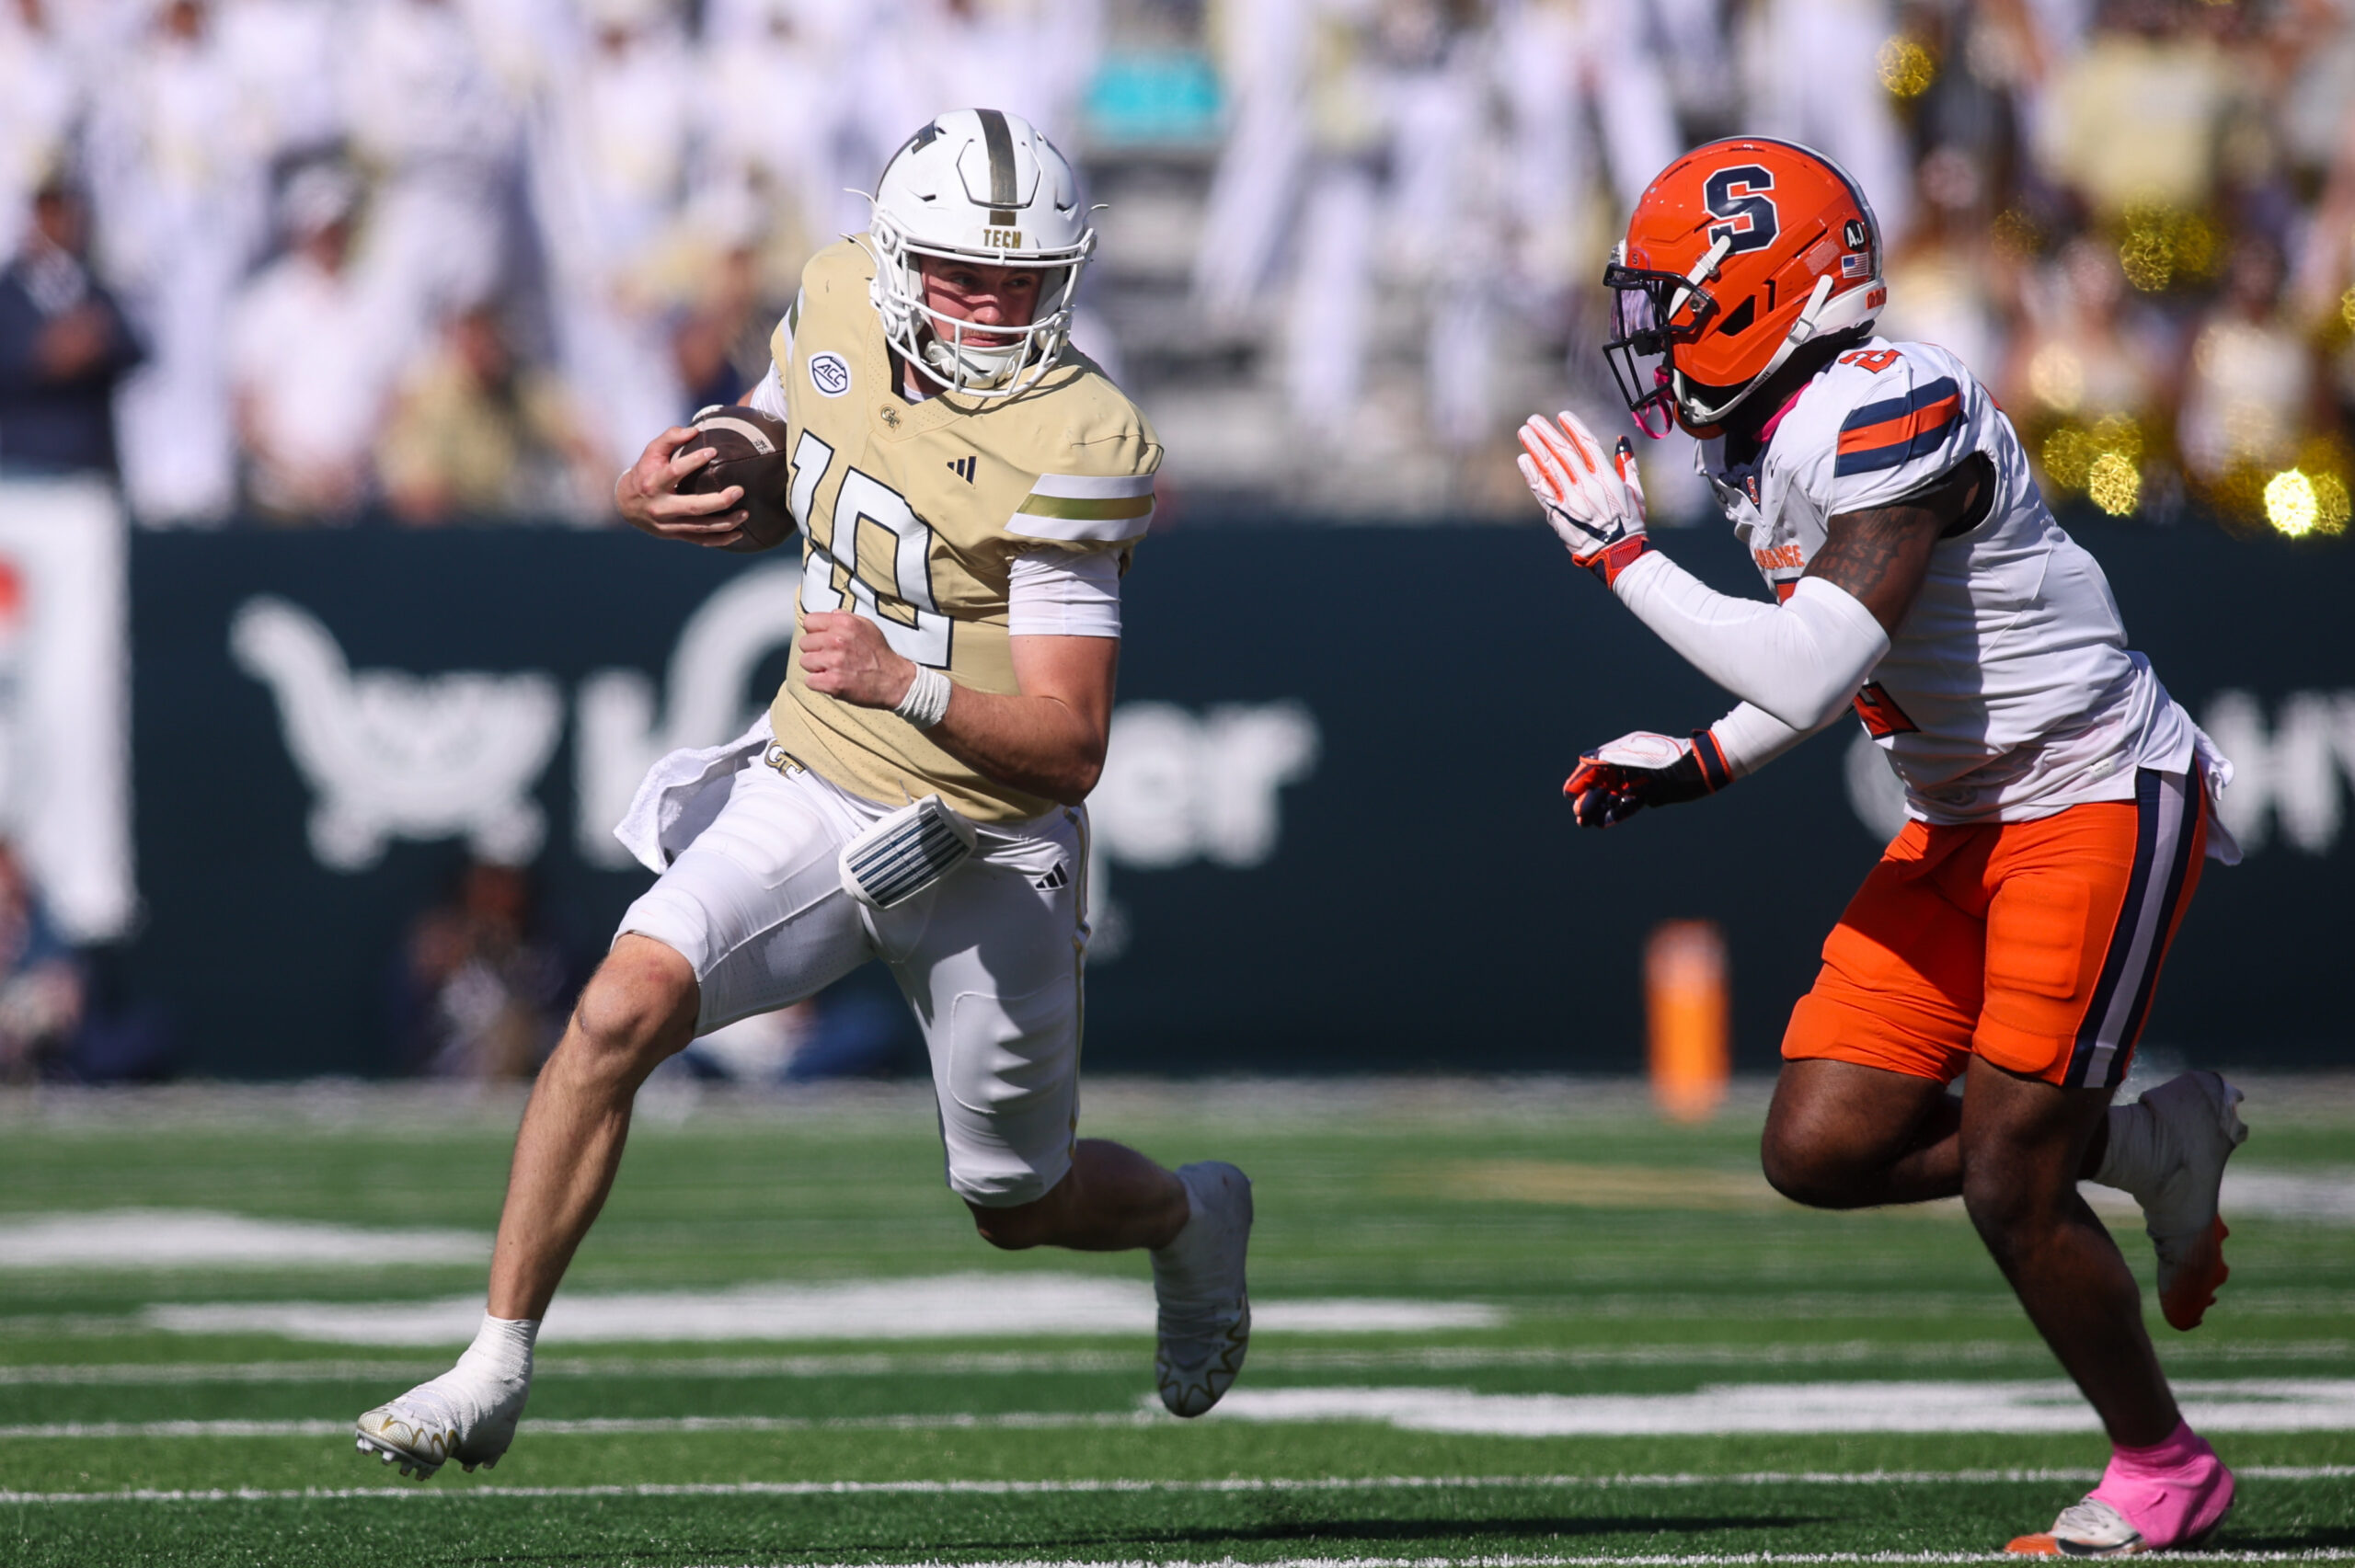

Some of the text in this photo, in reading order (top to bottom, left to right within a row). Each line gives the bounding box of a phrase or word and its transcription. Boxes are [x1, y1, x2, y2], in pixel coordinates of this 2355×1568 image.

[1703, 164, 1780, 255] S
[983, 229, 1022, 249] TECH
[1846, 223, 1865, 247] AJ
[817, 363, 846, 386] ACC
[790, 428, 955, 670] 10
